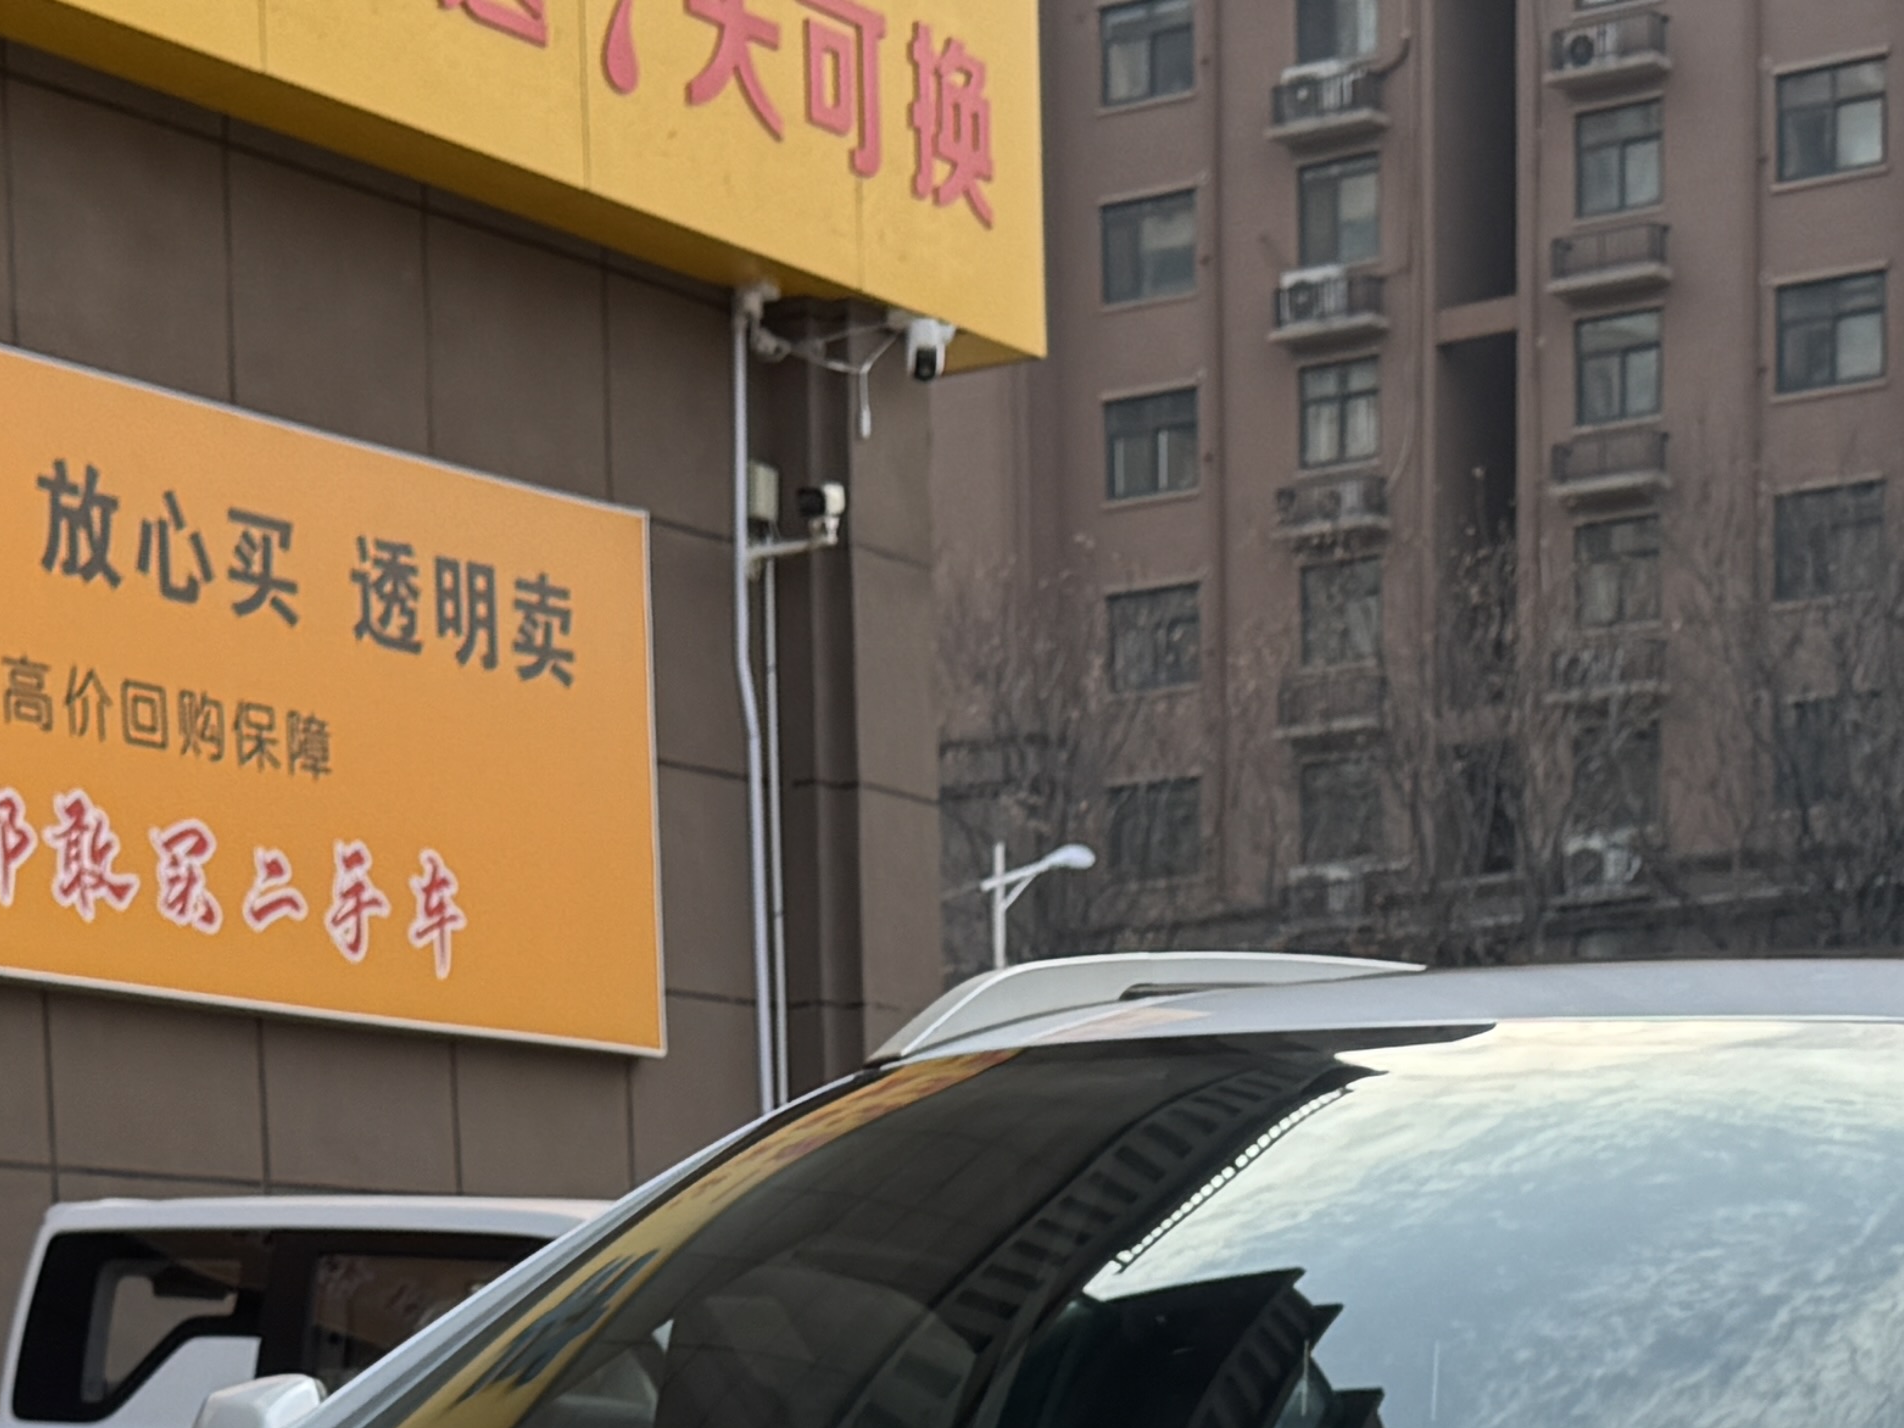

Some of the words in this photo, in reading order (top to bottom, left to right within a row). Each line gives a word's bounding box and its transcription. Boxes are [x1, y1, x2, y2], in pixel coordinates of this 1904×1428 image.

[441, 0, 994, 231] 天可换
[36, 458, 300, 626] 放心买
[350, 535, 577, 688] 透明卖
